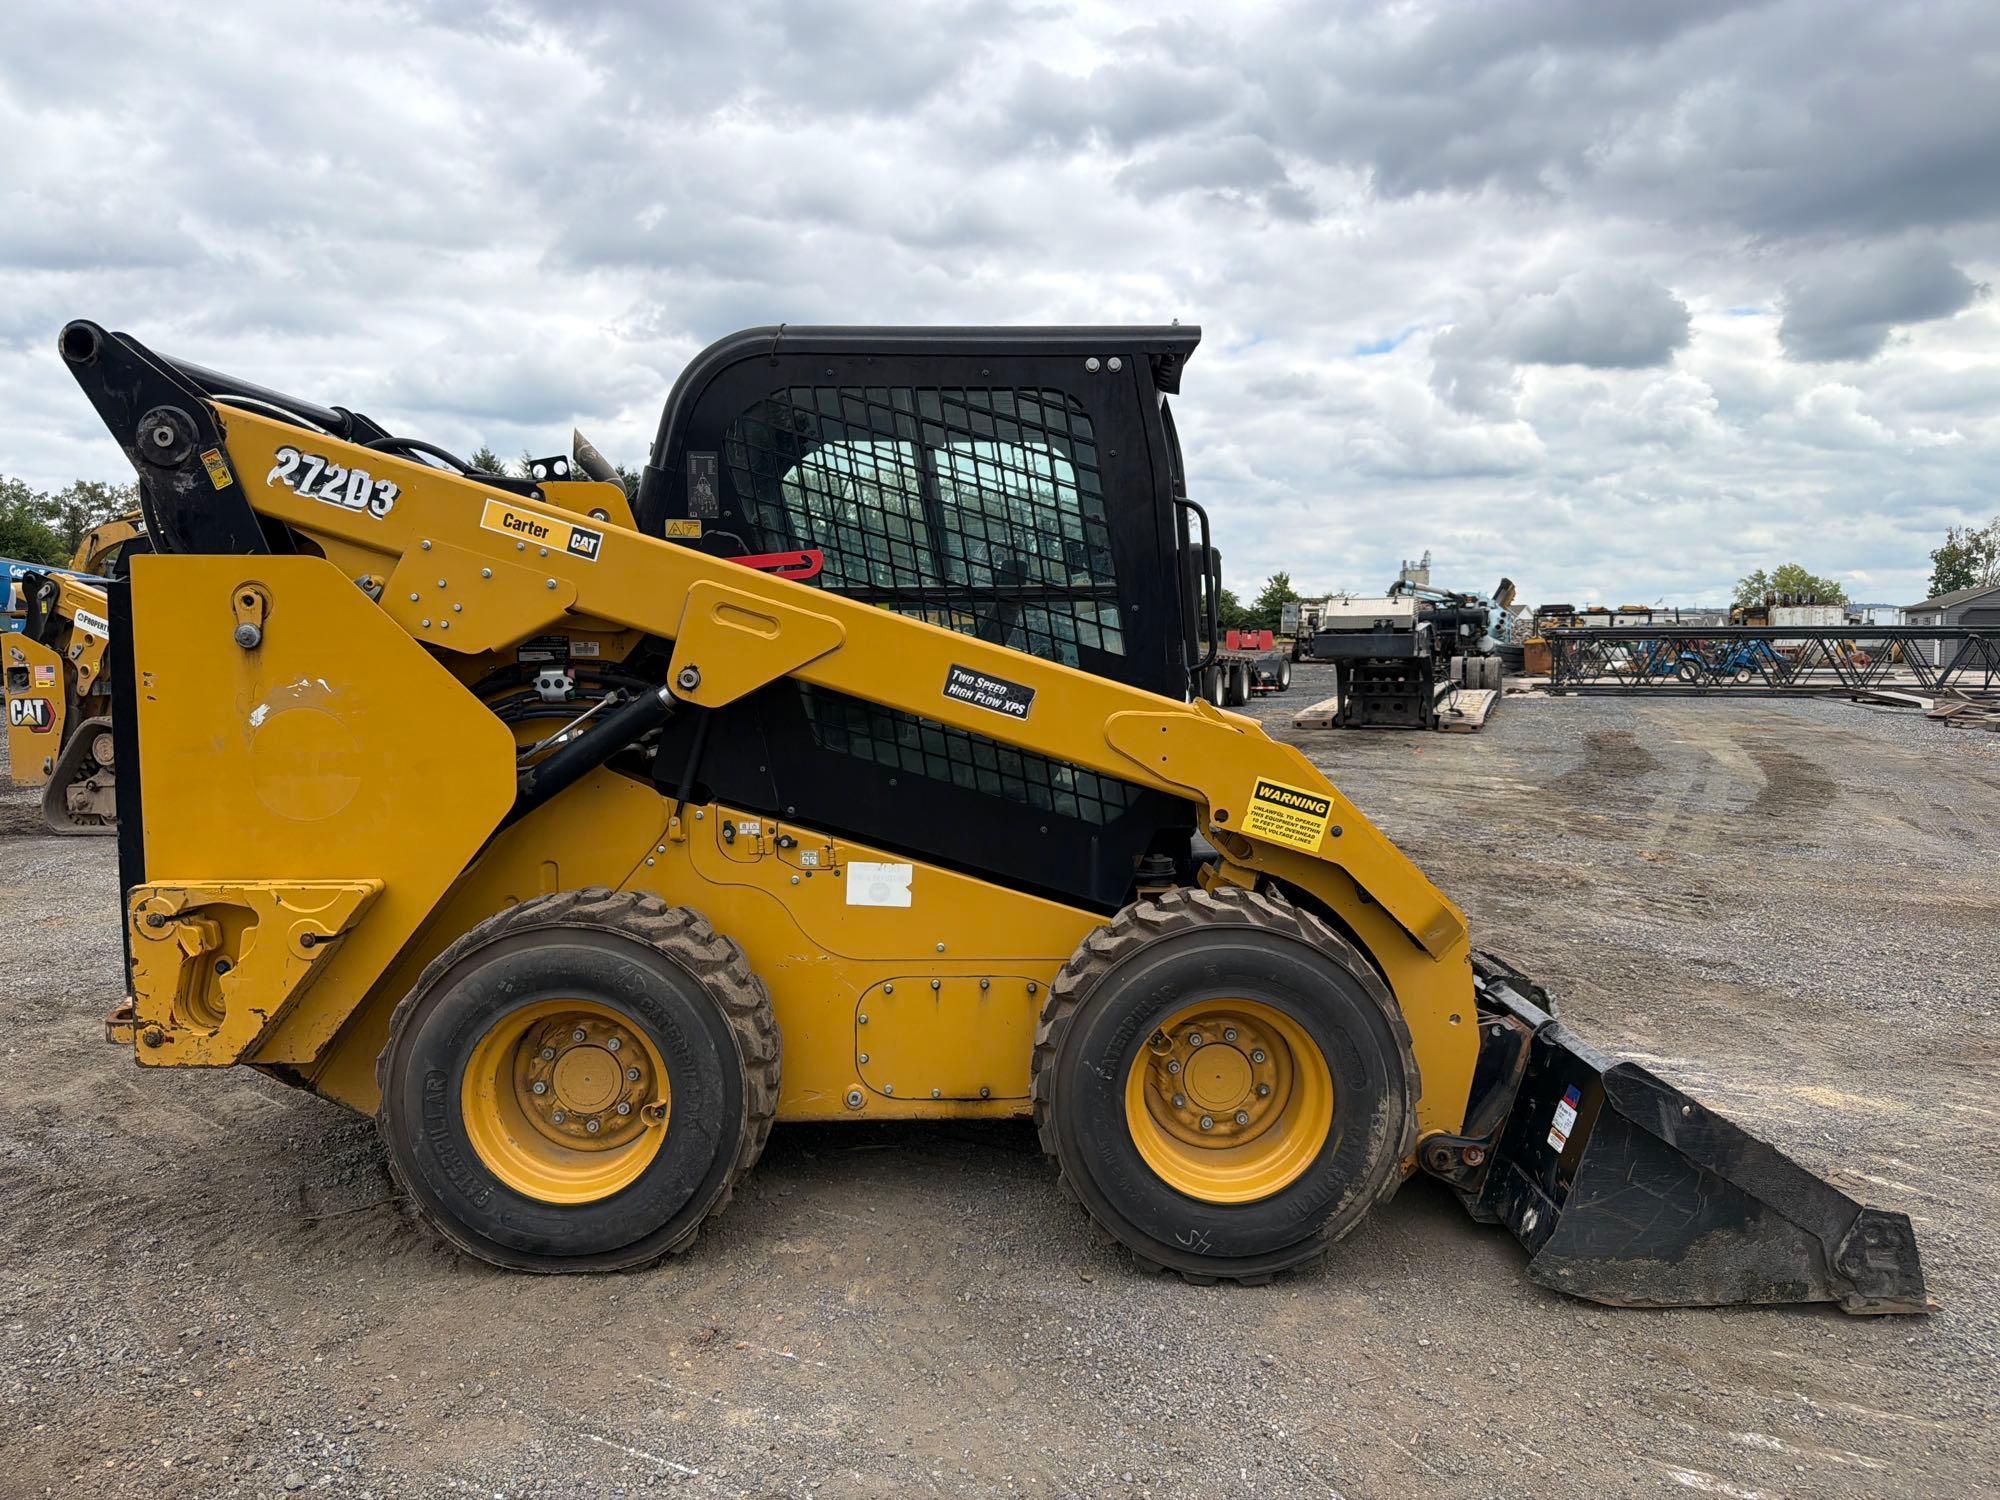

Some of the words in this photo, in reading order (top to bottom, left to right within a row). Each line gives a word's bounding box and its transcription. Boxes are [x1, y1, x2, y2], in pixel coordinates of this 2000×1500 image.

[266, 446, 400, 519] 272D3
[502, 512, 549, 539] Carter
[570, 533, 597, 553] CAT
[11, 699, 43, 726] CAT
[1002, 700, 1026, 715] XPS
[1258, 786, 1327, 813] WARNING
[1253, 805, 1284, 818] UNLAWFUL
[1295, 817, 1322, 828] OPERATE
[1260, 819, 1276, 827] FEET
[1284, 826, 1316, 840] OVERHEAD
[1264, 814, 1298, 828] EQUIPMENT
[1298, 825, 1321, 835] WITHIN
[1251, 823, 1267, 832] HIGH
[1268, 828, 1293, 840] VOLTAGE
[1294, 836, 1312, 845] LINES
[1099, 984, 1177, 1080] CATERPILLAR
[426, 1075, 492, 1207] CATERPILLAR
